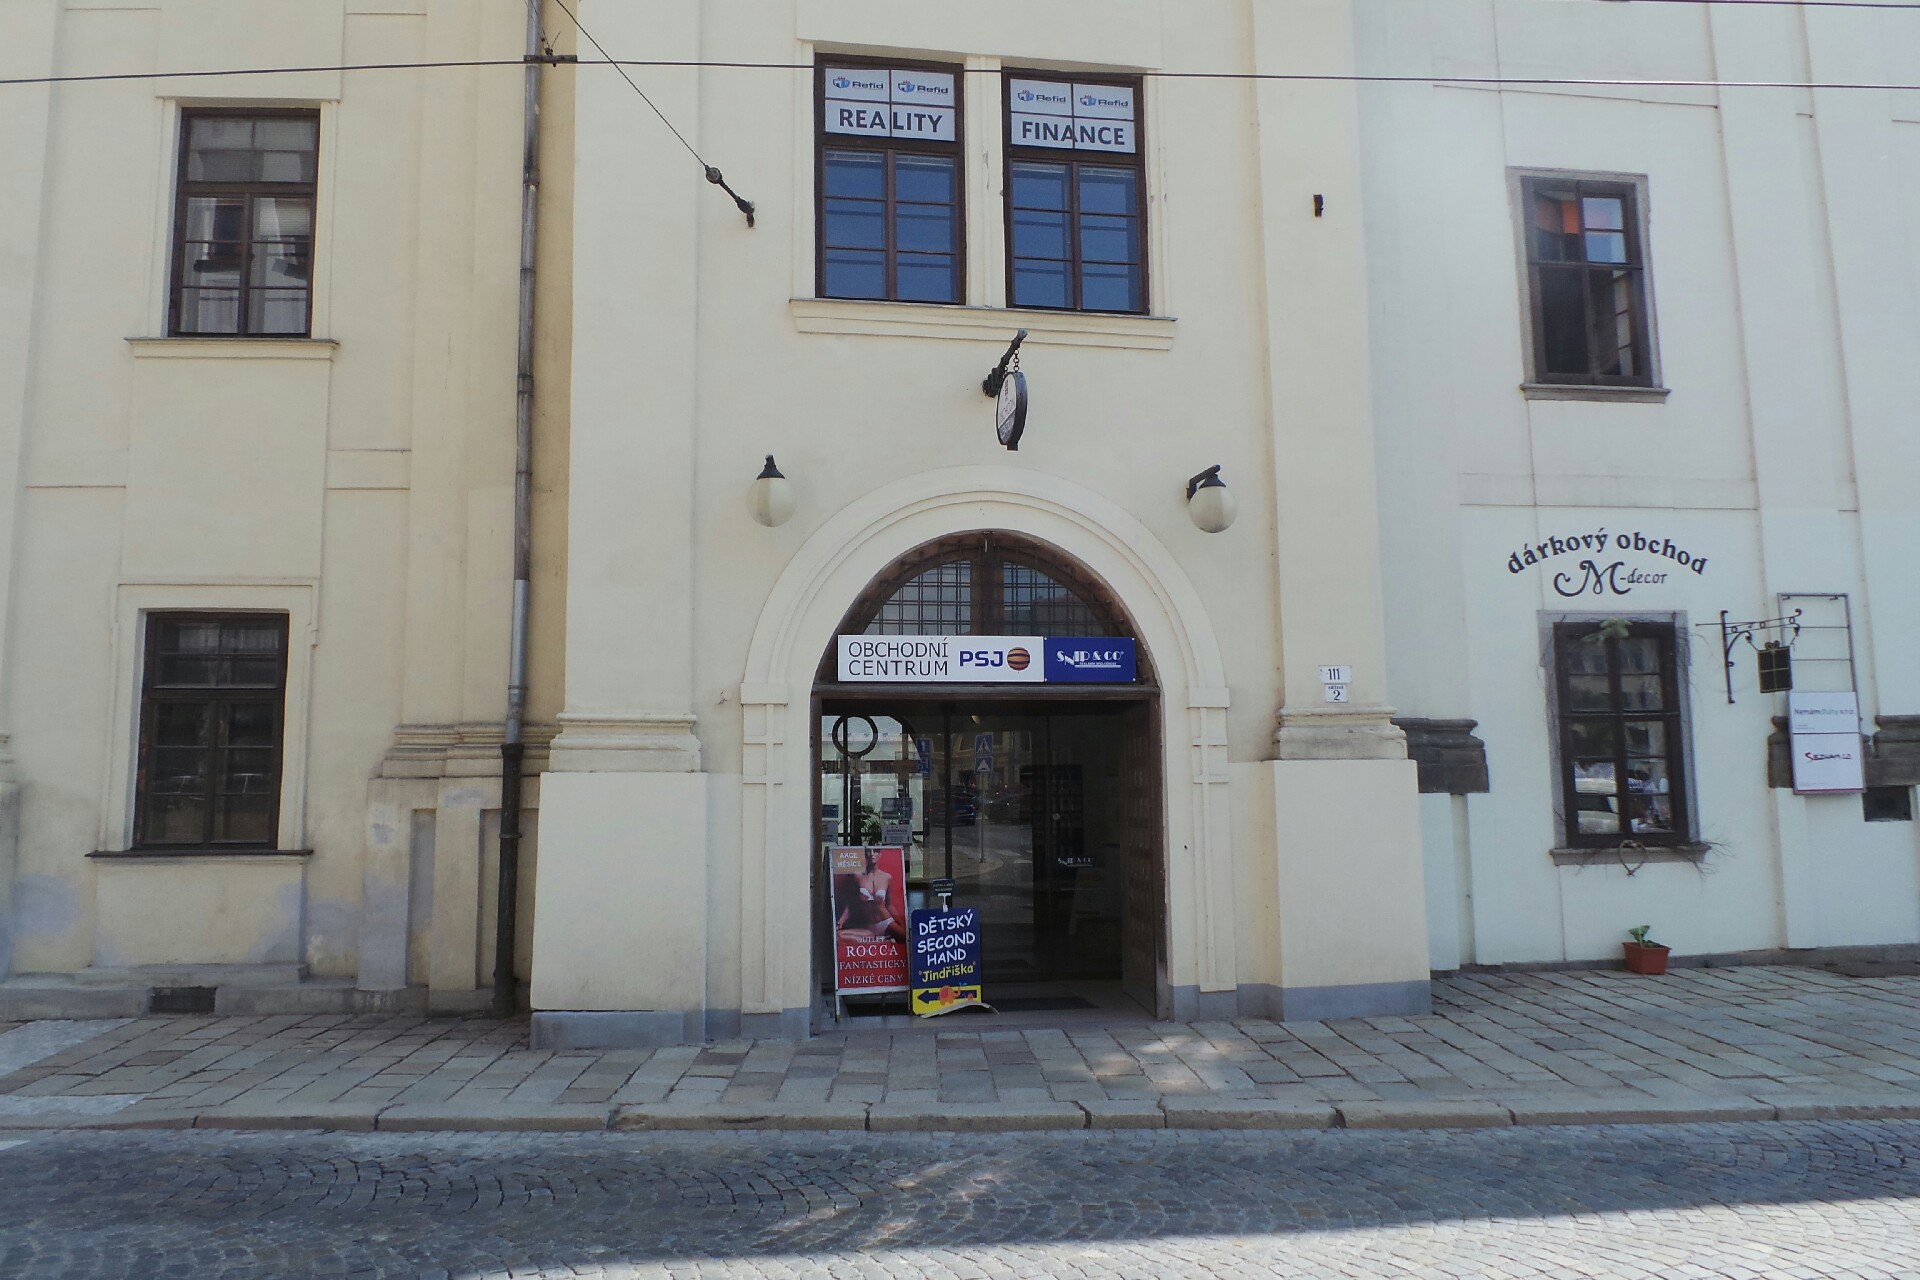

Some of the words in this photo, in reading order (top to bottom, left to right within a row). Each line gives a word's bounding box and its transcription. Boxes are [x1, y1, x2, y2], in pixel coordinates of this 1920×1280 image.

[852, 80, 884, 89] Refid
[917, 85, 949, 94] Refid
[1036, 94, 1066, 103] Refid
[1098, 98, 1129, 107] Refid
[839, 108, 943, 133] REALITY
[1022, 121, 1125, 146] FINANCE
[1507, 527, 1608, 575] dárkový
[1616, 532, 1708, 575] obchod
[848, 637, 949, 659] OBCHODNÍ
[959, 650, 1004, 667] PSJ
[848, 659, 948, 676] CENTRUM
[1328, 668, 1340, 680] 111
[1333, 689, 1341, 701] 2
[918, 908, 974, 936] DĚTSKÝ
[856, 935, 886, 943] OUTLET
[917, 931, 976, 953] SECOND
[846, 944, 899, 957] ROCCA
[926, 948, 967, 966] HAND
[840, 960, 907, 970] FANTASTICKY
[844, 973, 875, 985] NÍZKÉ
[877, 974, 903, 984] CENY
